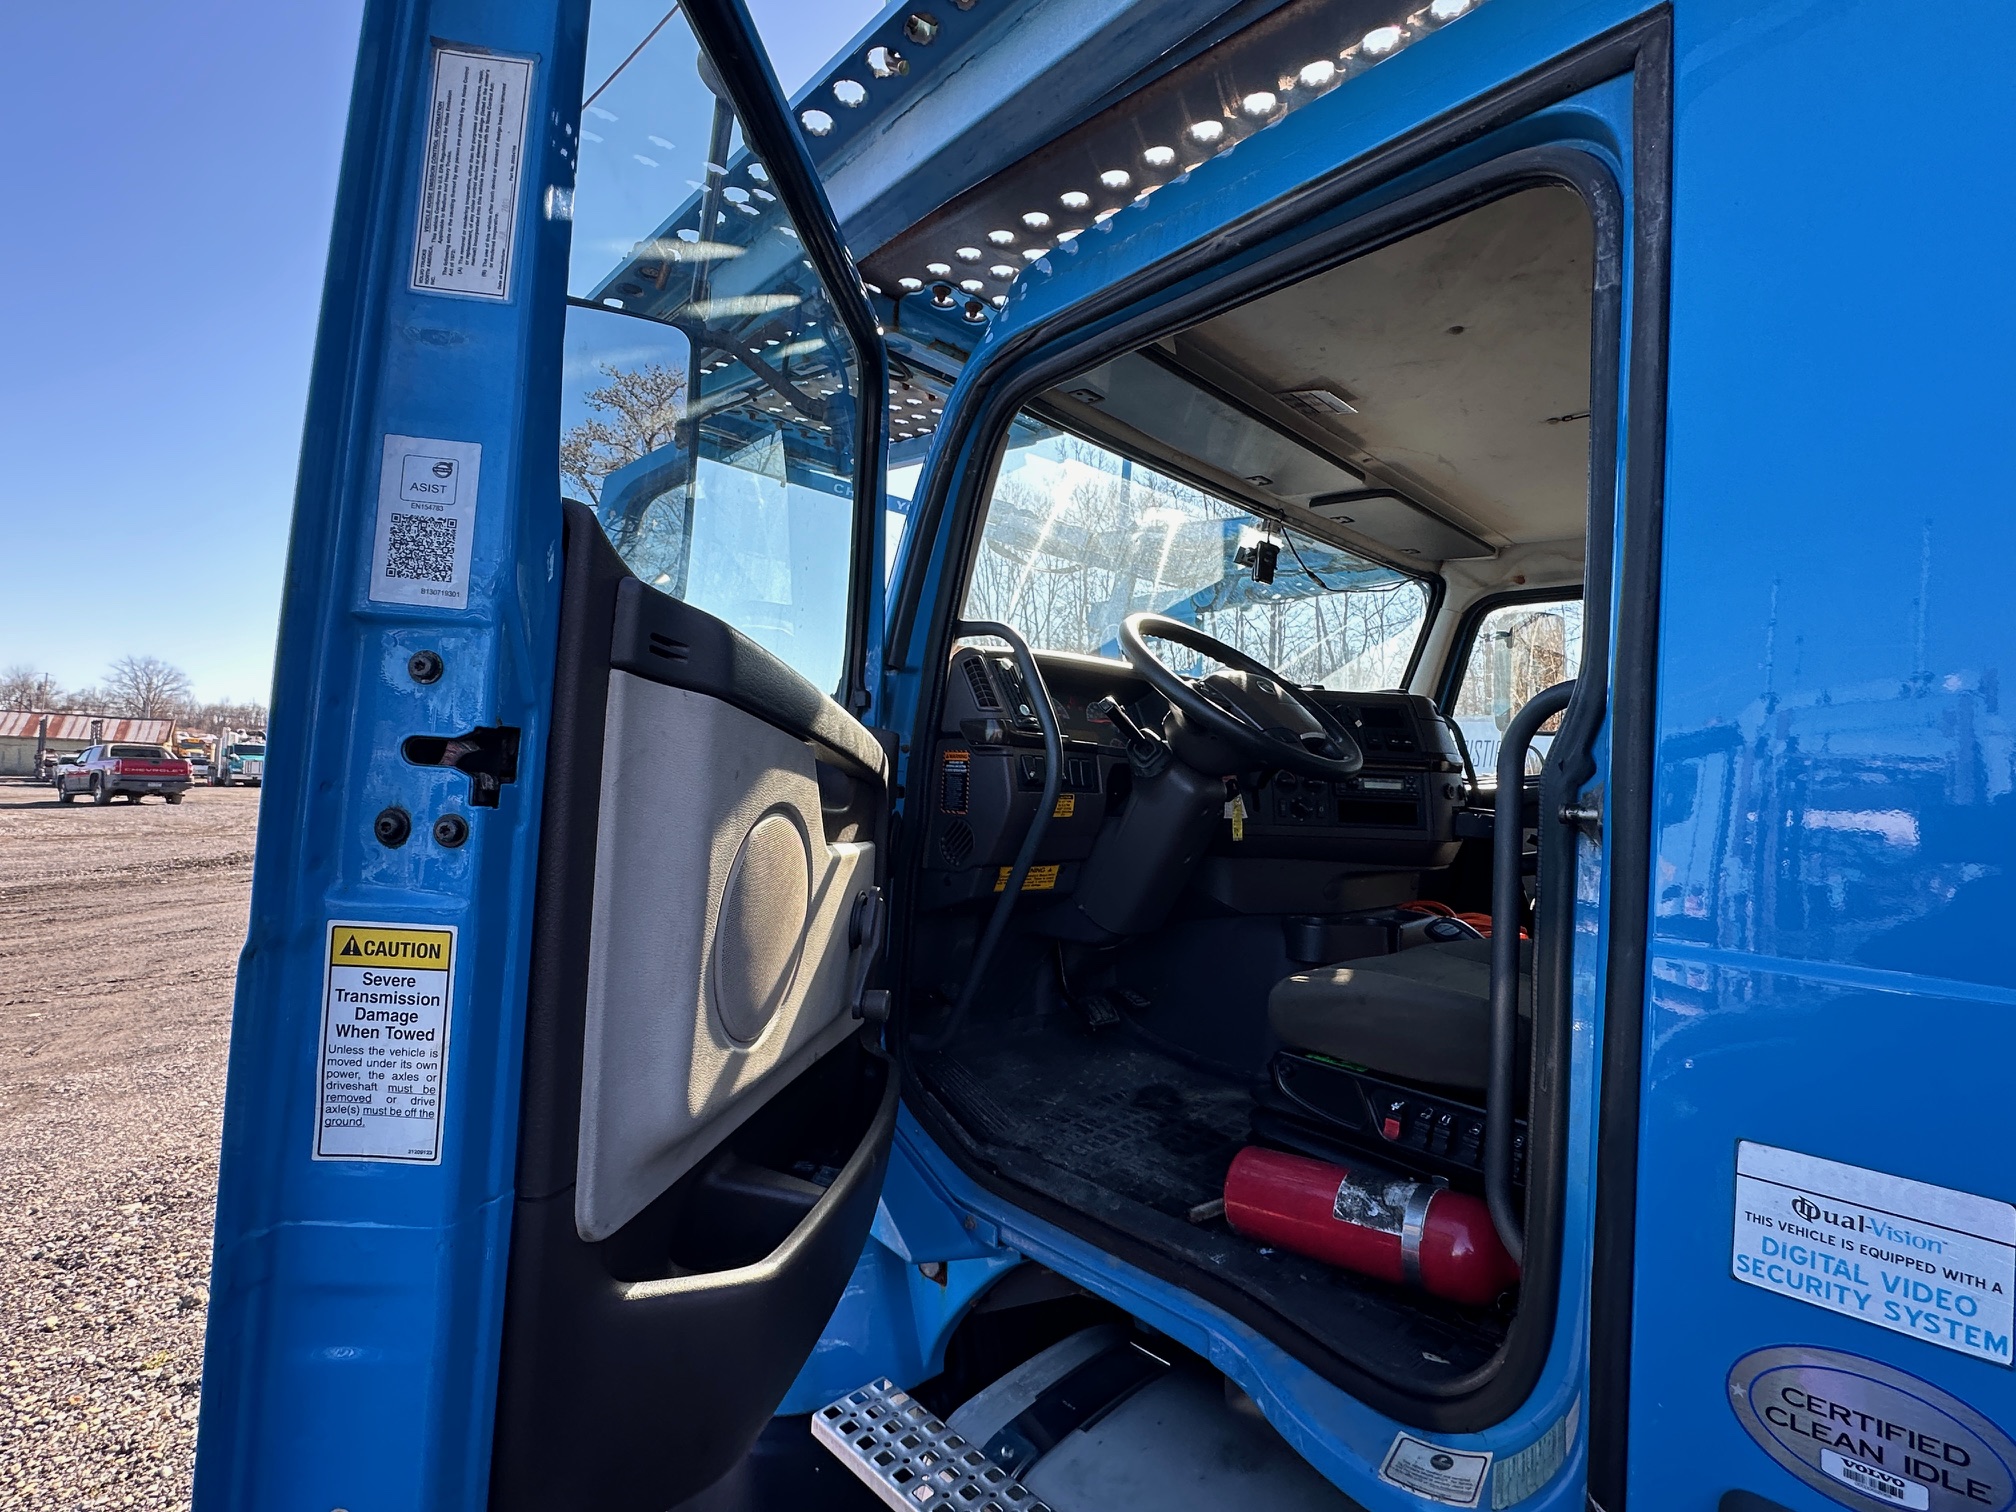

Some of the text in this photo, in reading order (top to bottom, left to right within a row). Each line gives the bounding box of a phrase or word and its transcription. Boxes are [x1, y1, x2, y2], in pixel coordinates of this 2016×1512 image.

[410, 482, 447, 494] ASIST
[411, 503, 443, 512] EN154783
[364, 941, 441, 959] CAUTION
[363, 972, 416, 987] Severe
[335, 989, 440, 1006] Transmission
[355, 1007, 418, 1025] Damage
[336, 1024, 435, 1041] When Towed
[329, 1044, 438, 1057] Unless the vehicle is
[327, 1058, 437, 1070] moved under its own
[327, 1071, 437, 1082] power, the axles or
[326, 1082, 436, 1094] driveshaft must be
[326, 1094, 372, 1103] removed
[411, 1097, 435, 1106] drive
[325, 1105, 434, 1119] axle(s) must be off the
[324, 1117, 365, 1127] ground.
[1745, 1210, 2003, 1295] THIS VEHICLE IS EQUIPPED WITH A
[1762, 1235, 1978, 1318] DIGITAL VIDEO
[1737, 1253, 2008, 1357] SECURITY SYSTEM
[1781, 1387, 1971, 1467] CERTIFIED
[1765, 1406, 1992, 1505] CLEAN IDLE
[1841, 1457, 1905, 1488] VOLVO
